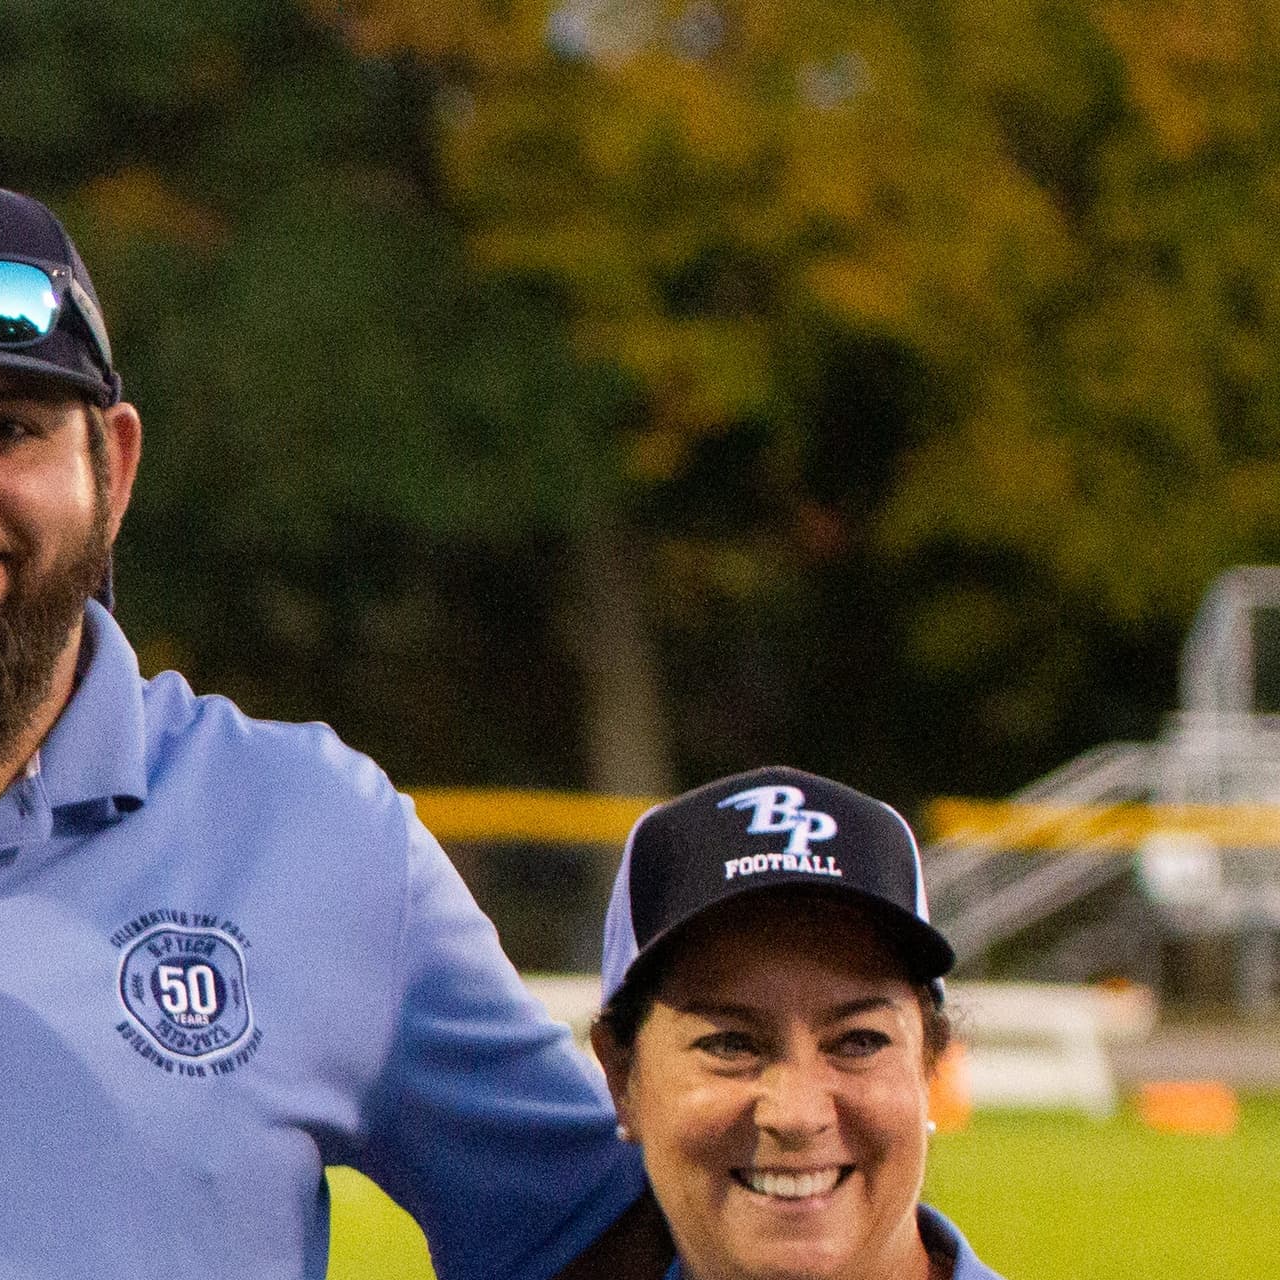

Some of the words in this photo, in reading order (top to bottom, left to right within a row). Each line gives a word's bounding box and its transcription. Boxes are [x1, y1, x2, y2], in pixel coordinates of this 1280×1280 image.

[724, 853, 842, 880] FOOTBALL
[158, 964, 218, 1015] 50
[172, 1013, 210, 1025] YEARS
